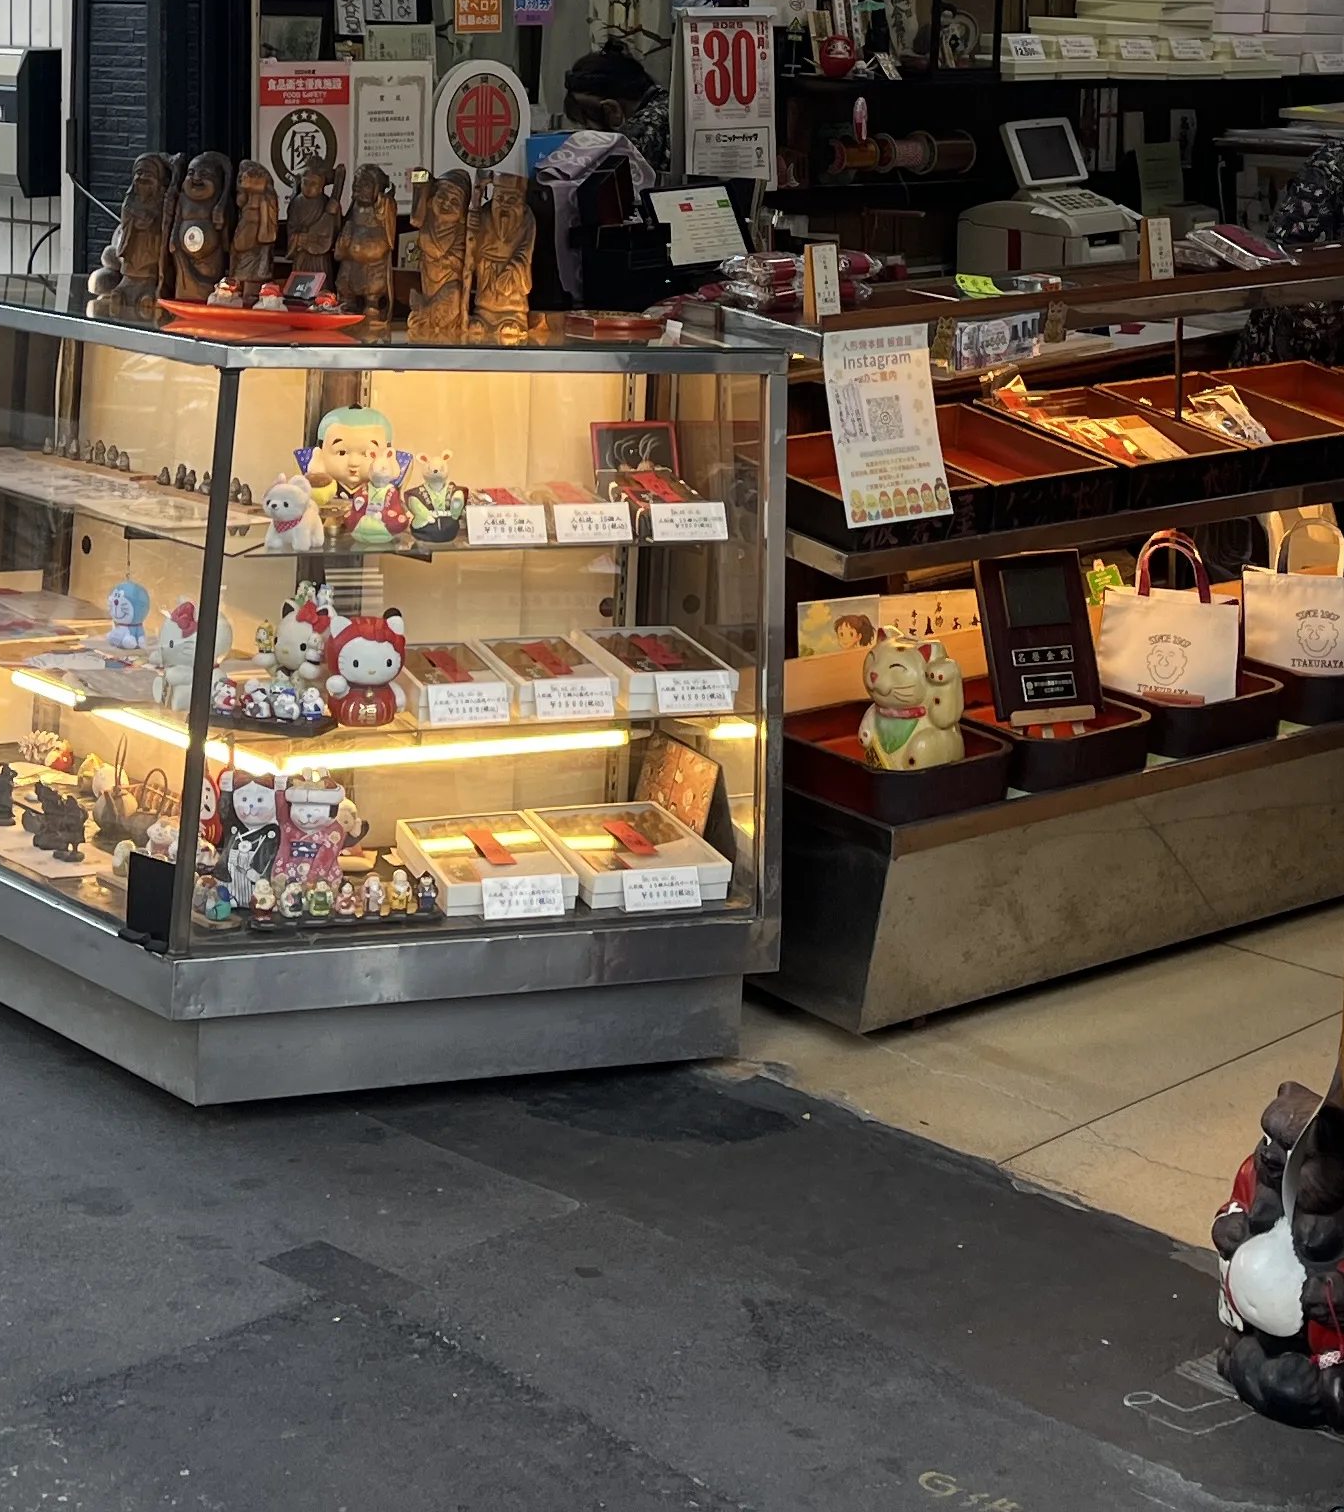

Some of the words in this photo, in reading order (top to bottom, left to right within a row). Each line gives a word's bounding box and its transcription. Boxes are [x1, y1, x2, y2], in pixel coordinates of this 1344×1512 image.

[703, 29, 757, 106] 30
[842, 352, 912, 370] Instagram
[1295, 609, 1318, 621] SINCE
[1291, 658, 1344, 669] ITAKURAYA
